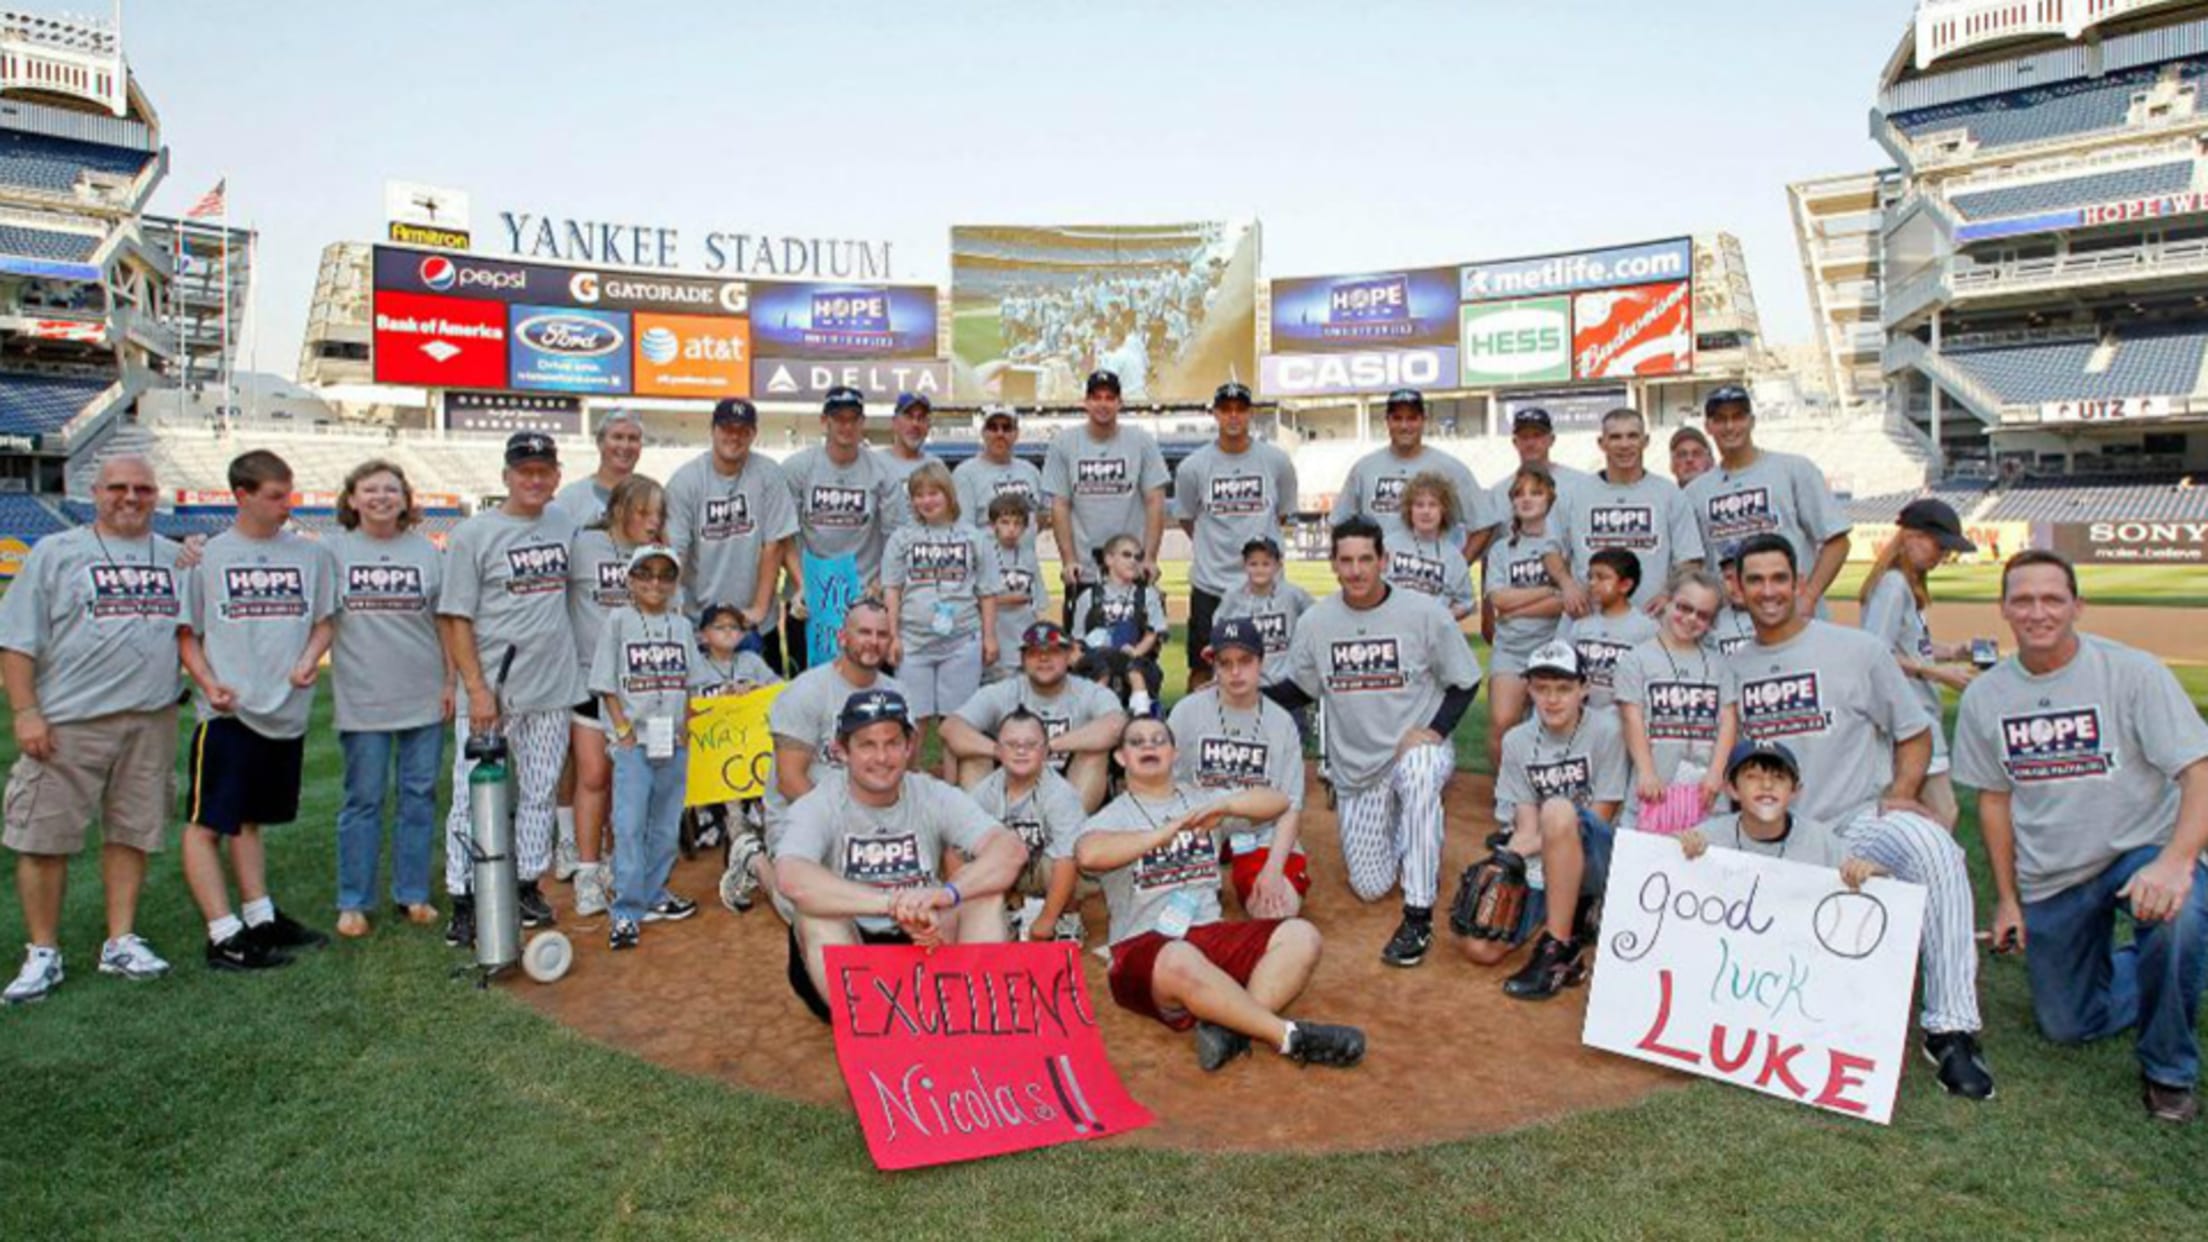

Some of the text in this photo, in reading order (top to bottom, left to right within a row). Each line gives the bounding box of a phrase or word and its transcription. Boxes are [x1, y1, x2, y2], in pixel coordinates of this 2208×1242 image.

[392, 224, 467, 249] Armitron
[500, 211, 892, 279] YANKEE STADIUM
[459, 267, 525, 289] pepsi
[1495, 250, 1680, 290] metlife.com
[605, 281, 713, 303] GATORADE
[1333, 283, 1401, 309] HOPE
[814, 297, 882, 319] HOPE
[377, 314, 503, 340] Bank of America
[539, 323, 598, 349] Ford
[684, 335, 744, 361] at&t
[1472, 327, 1561, 355] HESS
[810, 366, 937, 391] DELTA
[1277, 353, 1440, 390] CASIO
[2078, 400, 2125, 419] UTZ
[1712, 491, 1765, 514] HOPE
[1594, 511, 1648, 527] HOPE
[2090, 522, 2208, 542] SONY
[511, 548, 566, 568] HOPE
[96, 568, 170, 590] HOPE
[230, 568, 299, 590] HOPE
[352, 567, 416, 587] HOPE
[1334, 643, 1395, 664] HOPE
[1653, 685, 1717, 708] HOPE
[1745, 677, 1814, 707] HOPE
[2008, 715, 2096, 745] HOPE
[1204, 741, 1263, 765] HOPE
[850, 840, 916, 864] HOPE
[1611, 871, 1774, 962] good
[1636, 969, 1876, 1114] LUKE
